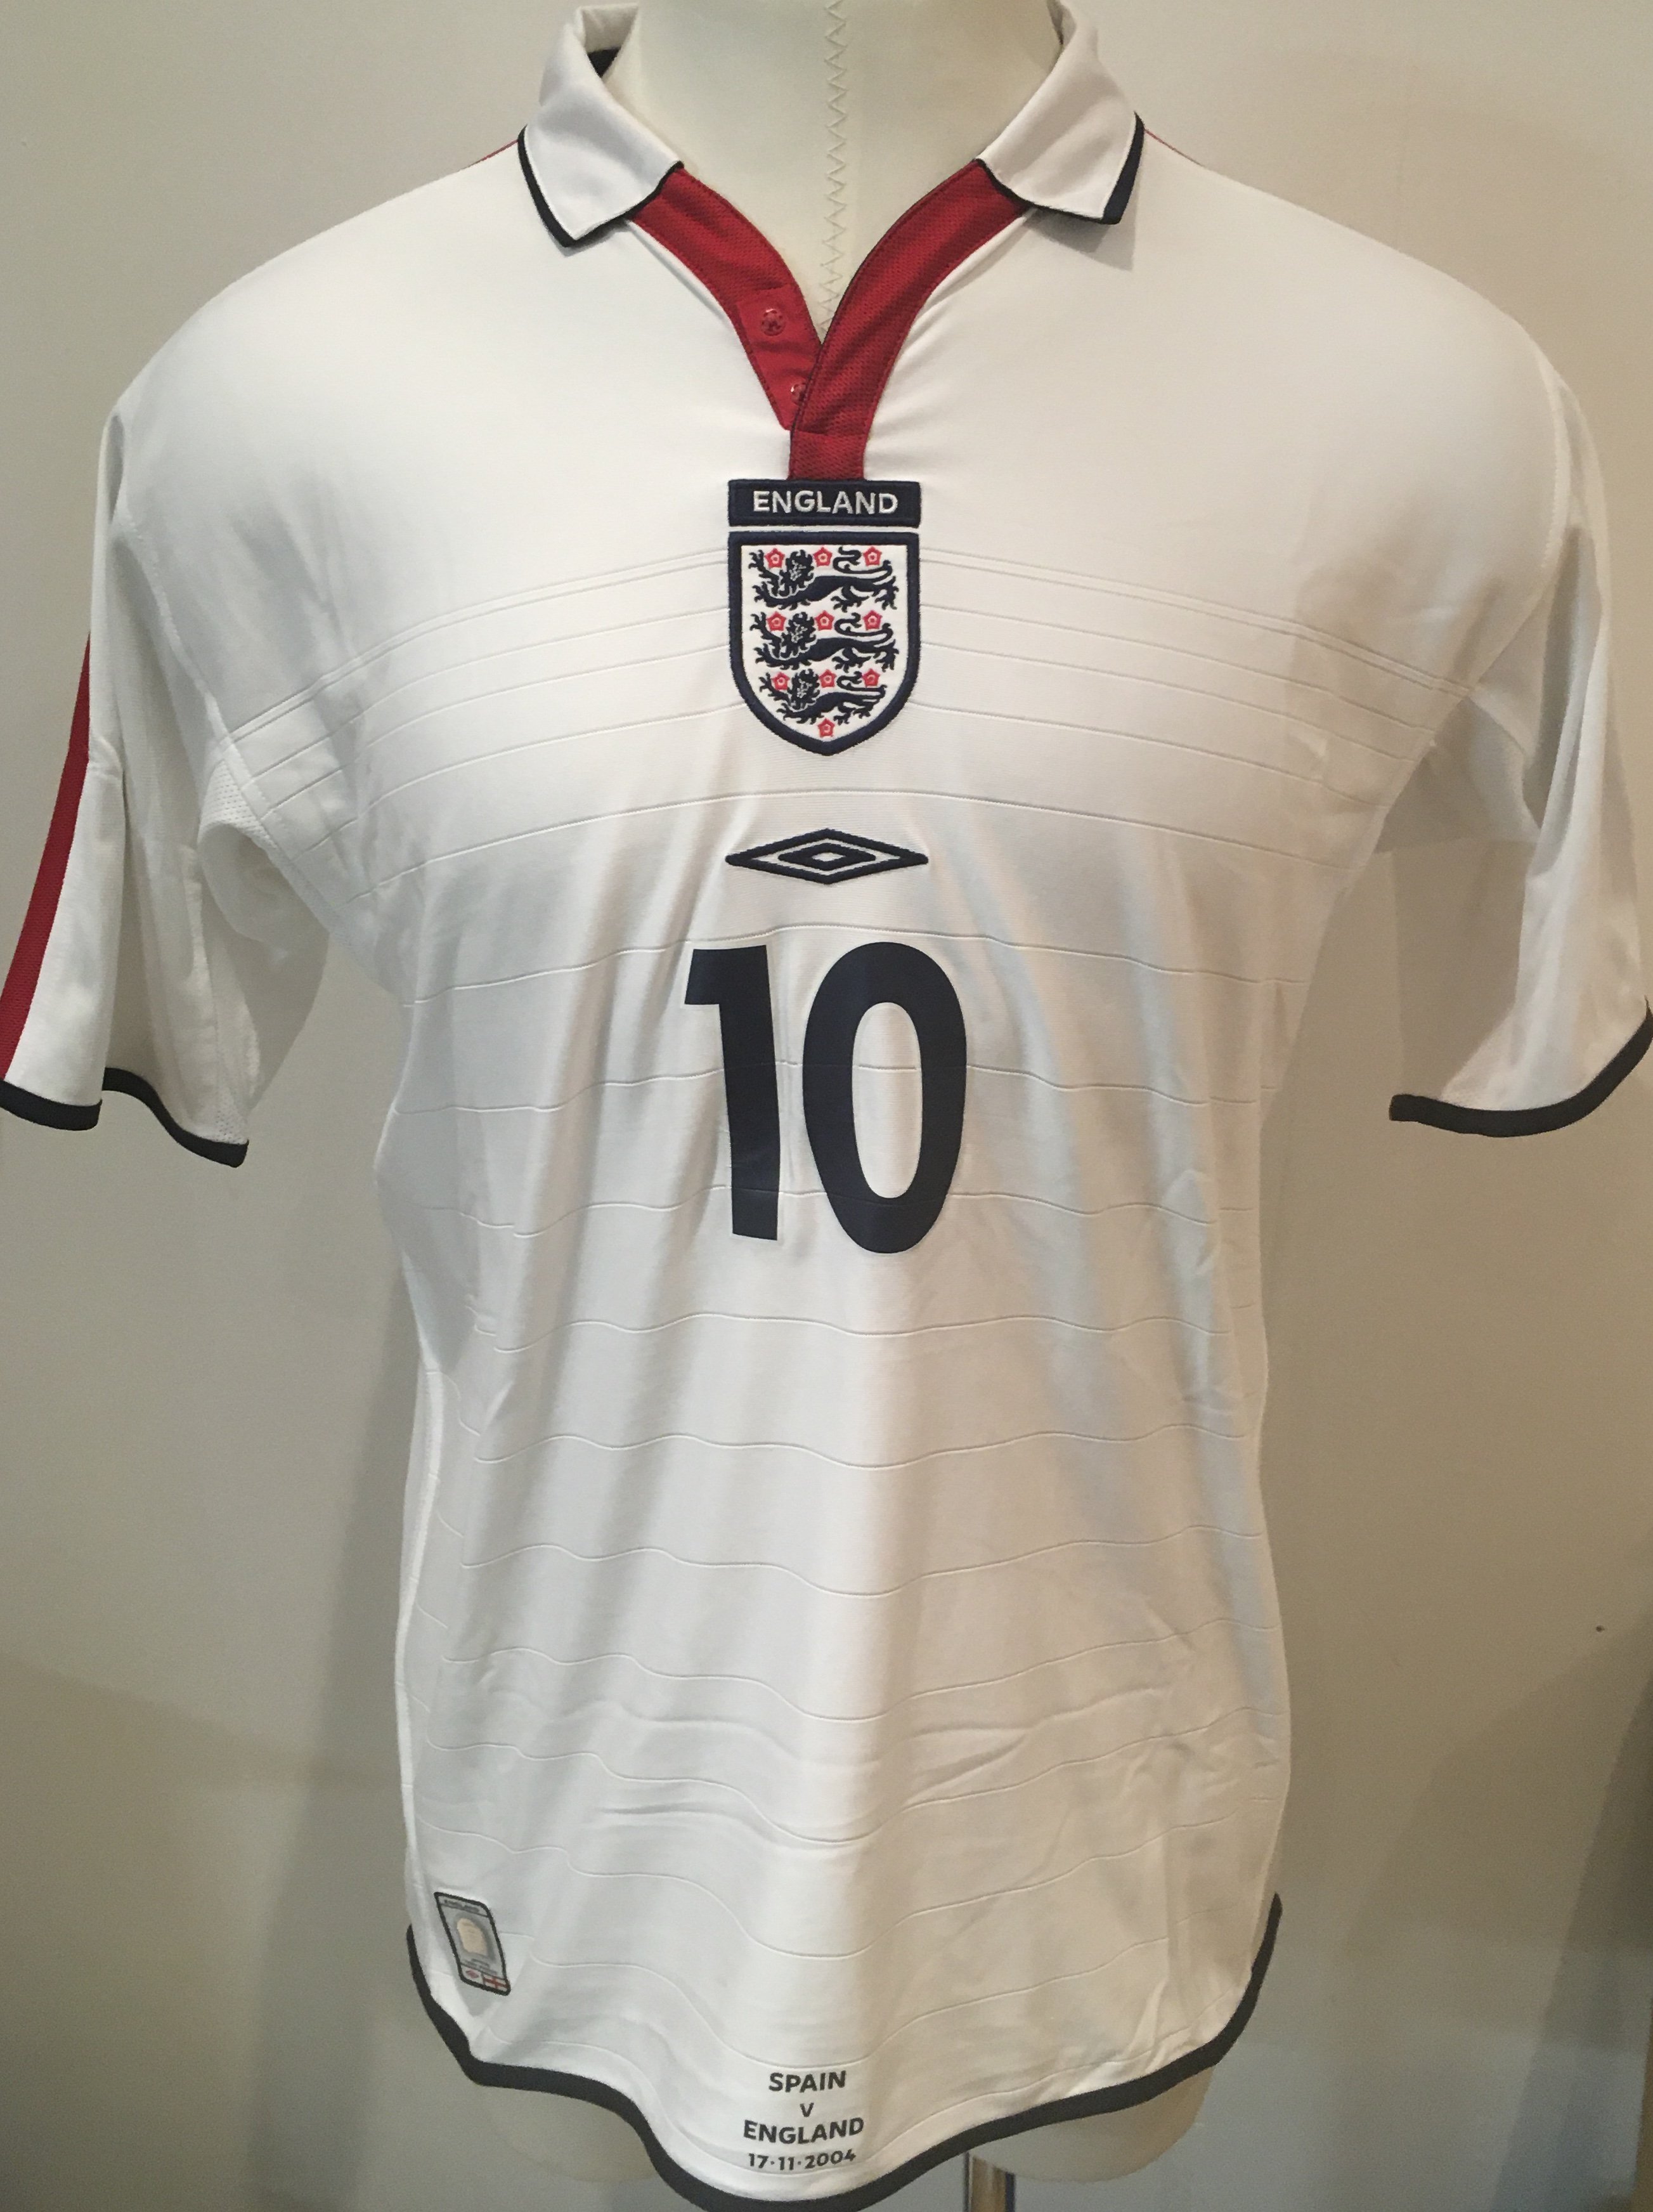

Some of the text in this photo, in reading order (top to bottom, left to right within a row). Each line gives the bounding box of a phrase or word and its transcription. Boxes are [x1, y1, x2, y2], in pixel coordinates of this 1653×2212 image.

[753, 490, 898, 515] ENGLAND
[685, 942, 967, 1253] 10
[768, 2070, 847, 2093] SPAIN
[743, 2116, 864, 2145] ENGLAND
